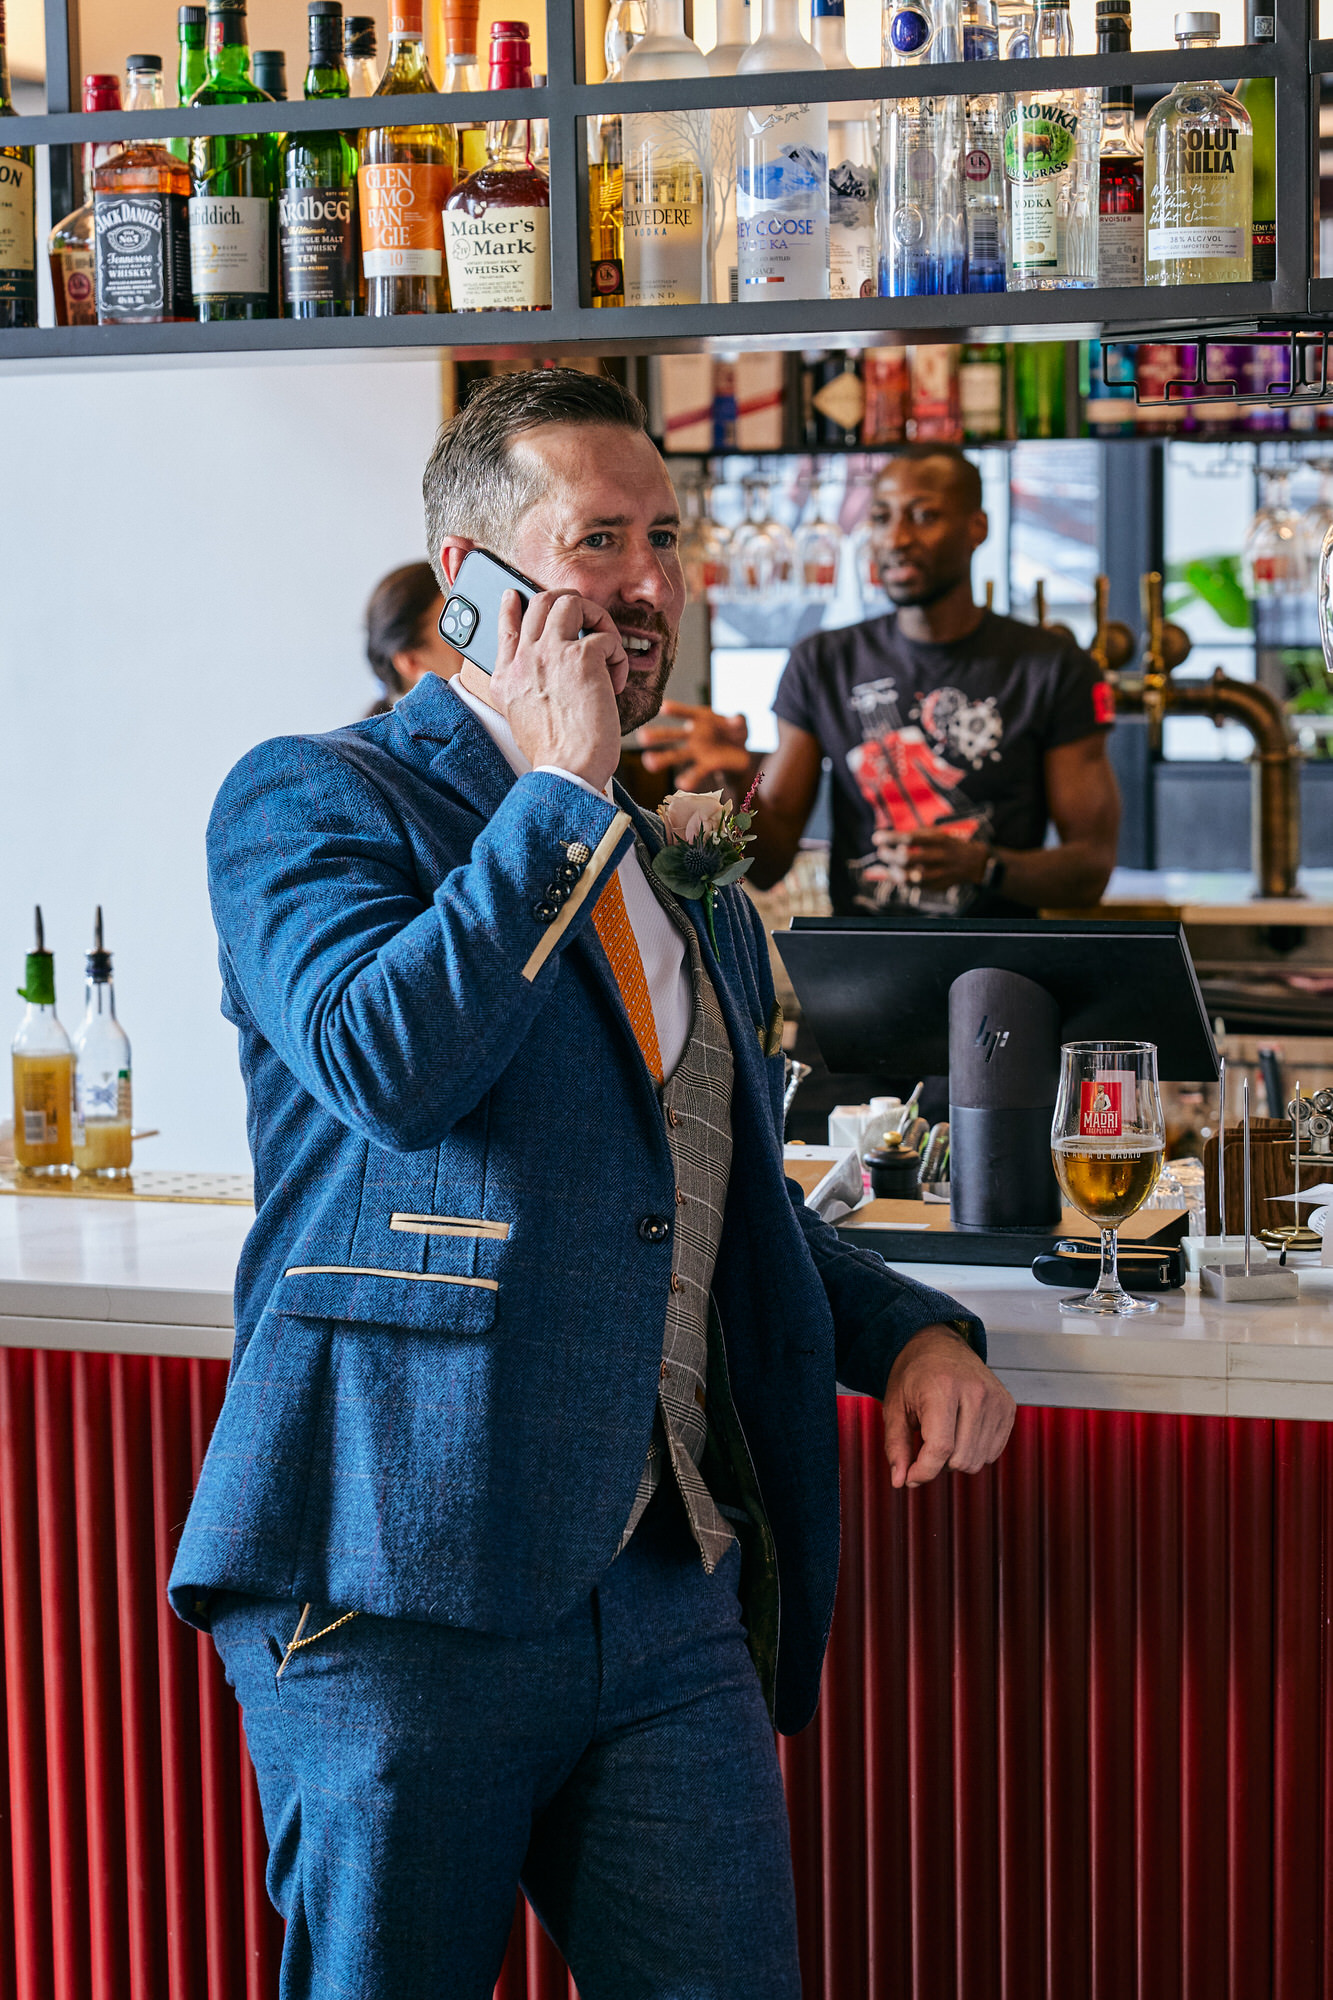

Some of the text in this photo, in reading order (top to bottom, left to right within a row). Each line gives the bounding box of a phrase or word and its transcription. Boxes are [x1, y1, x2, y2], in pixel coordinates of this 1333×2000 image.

[970, 156, 986, 167] UK
[1032, 160, 1068, 178] GRASS
[366, 168, 412, 189] GLEN
[380, 188, 415, 207] MO
[1014, 199, 1052, 209] VODKA
[96, 208, 122, 233] JACK
[368, 208, 402, 228] RAN
[451, 219, 535, 236] Maker's
[634, 228, 667, 236] VODKA
[756, 219, 814, 235] GOOSE
[322, 235, 344, 243] MALT
[381, 226, 410, 247] GIE
[305, 244, 337, 252] WHISKY
[473, 239, 535, 256] Mark
[296, 254, 318, 263] TEN
[108, 268, 153, 278] WHISKEY
[464, 264, 522, 275] WHISKY
